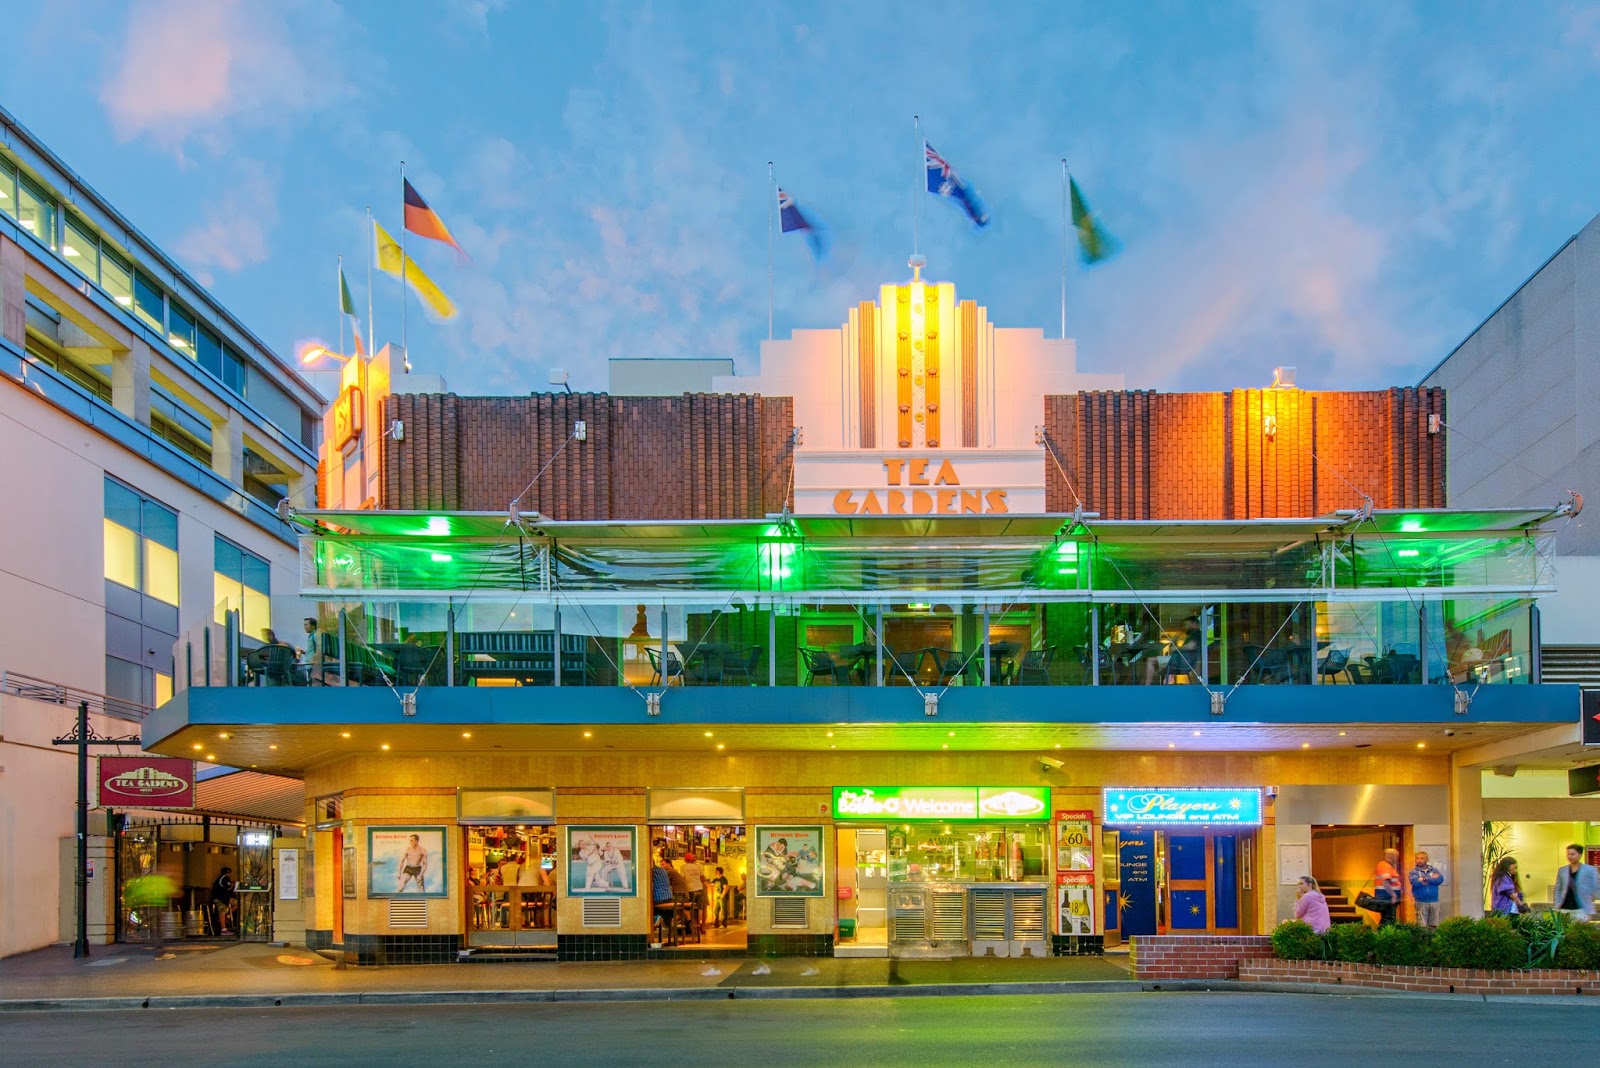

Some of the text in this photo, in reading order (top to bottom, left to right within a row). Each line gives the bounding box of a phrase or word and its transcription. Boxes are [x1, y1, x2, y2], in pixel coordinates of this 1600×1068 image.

[883, 458, 960, 485] TEA
[833, 490, 1009, 514] GARDENS
[904, 798, 976, 813] Welcome
[1127, 793, 1222, 814] Players
[1061, 812, 1087, 821] Specials
[1062, 876, 1088, 885] Specials
